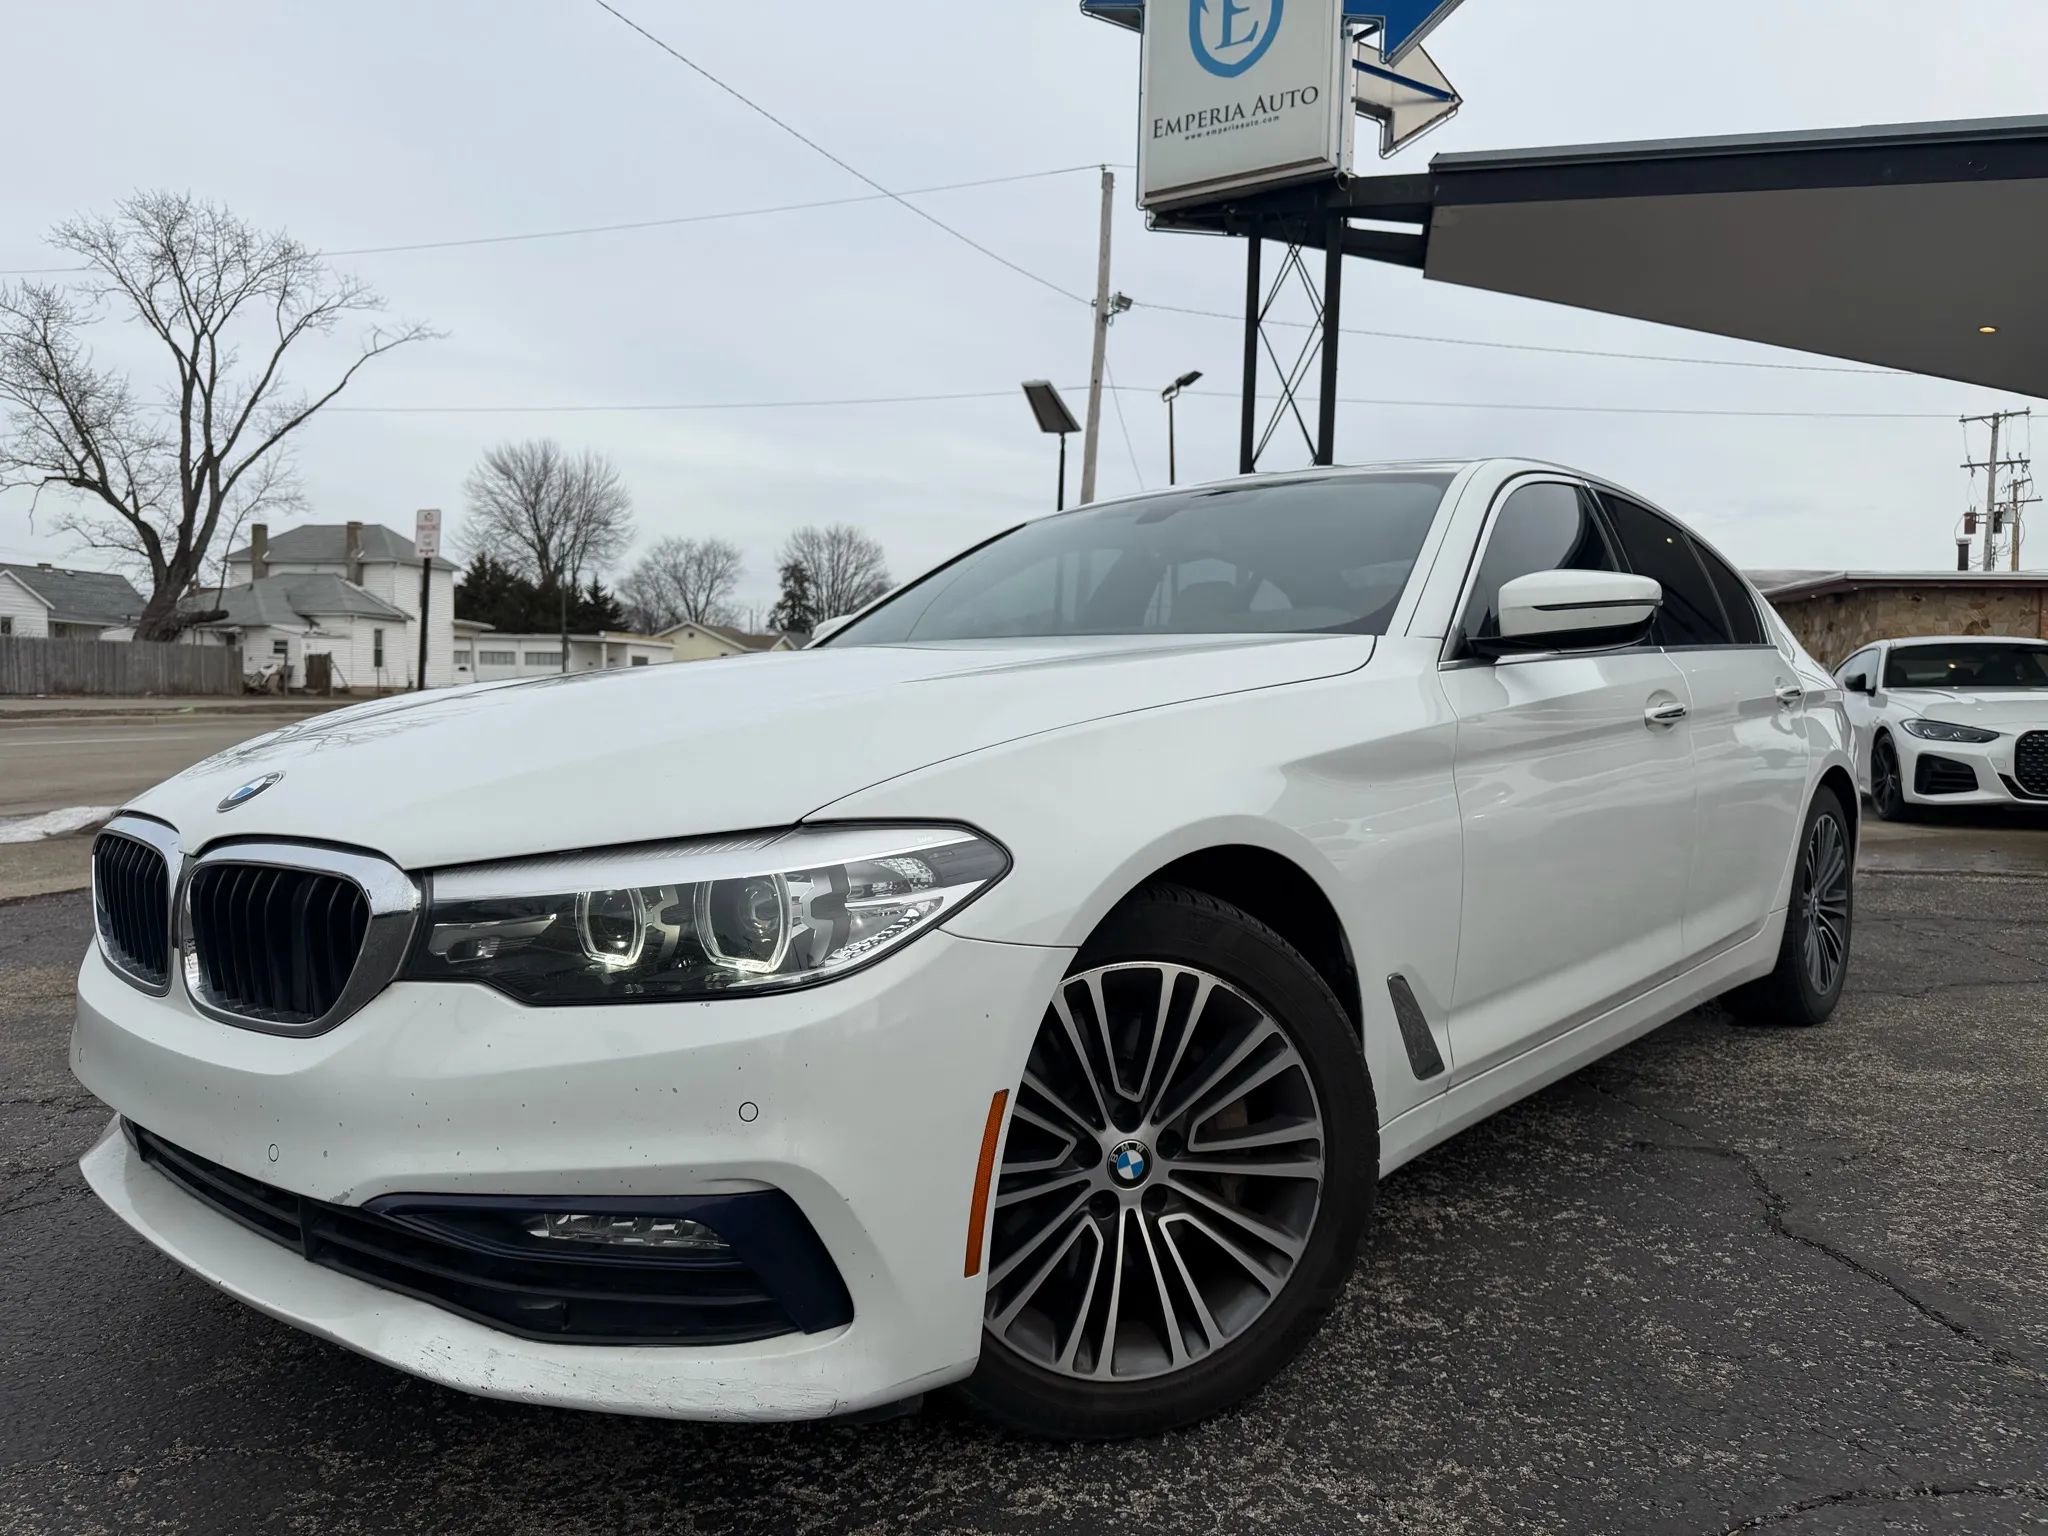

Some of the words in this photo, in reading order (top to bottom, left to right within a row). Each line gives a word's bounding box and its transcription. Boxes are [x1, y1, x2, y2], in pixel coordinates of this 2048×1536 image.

[1152, 102, 1245, 139] EMPERIA
[1185, 115, 1280, 140] www.emperiaauto.com
[1110, 1142, 1145, 1163] BMW
